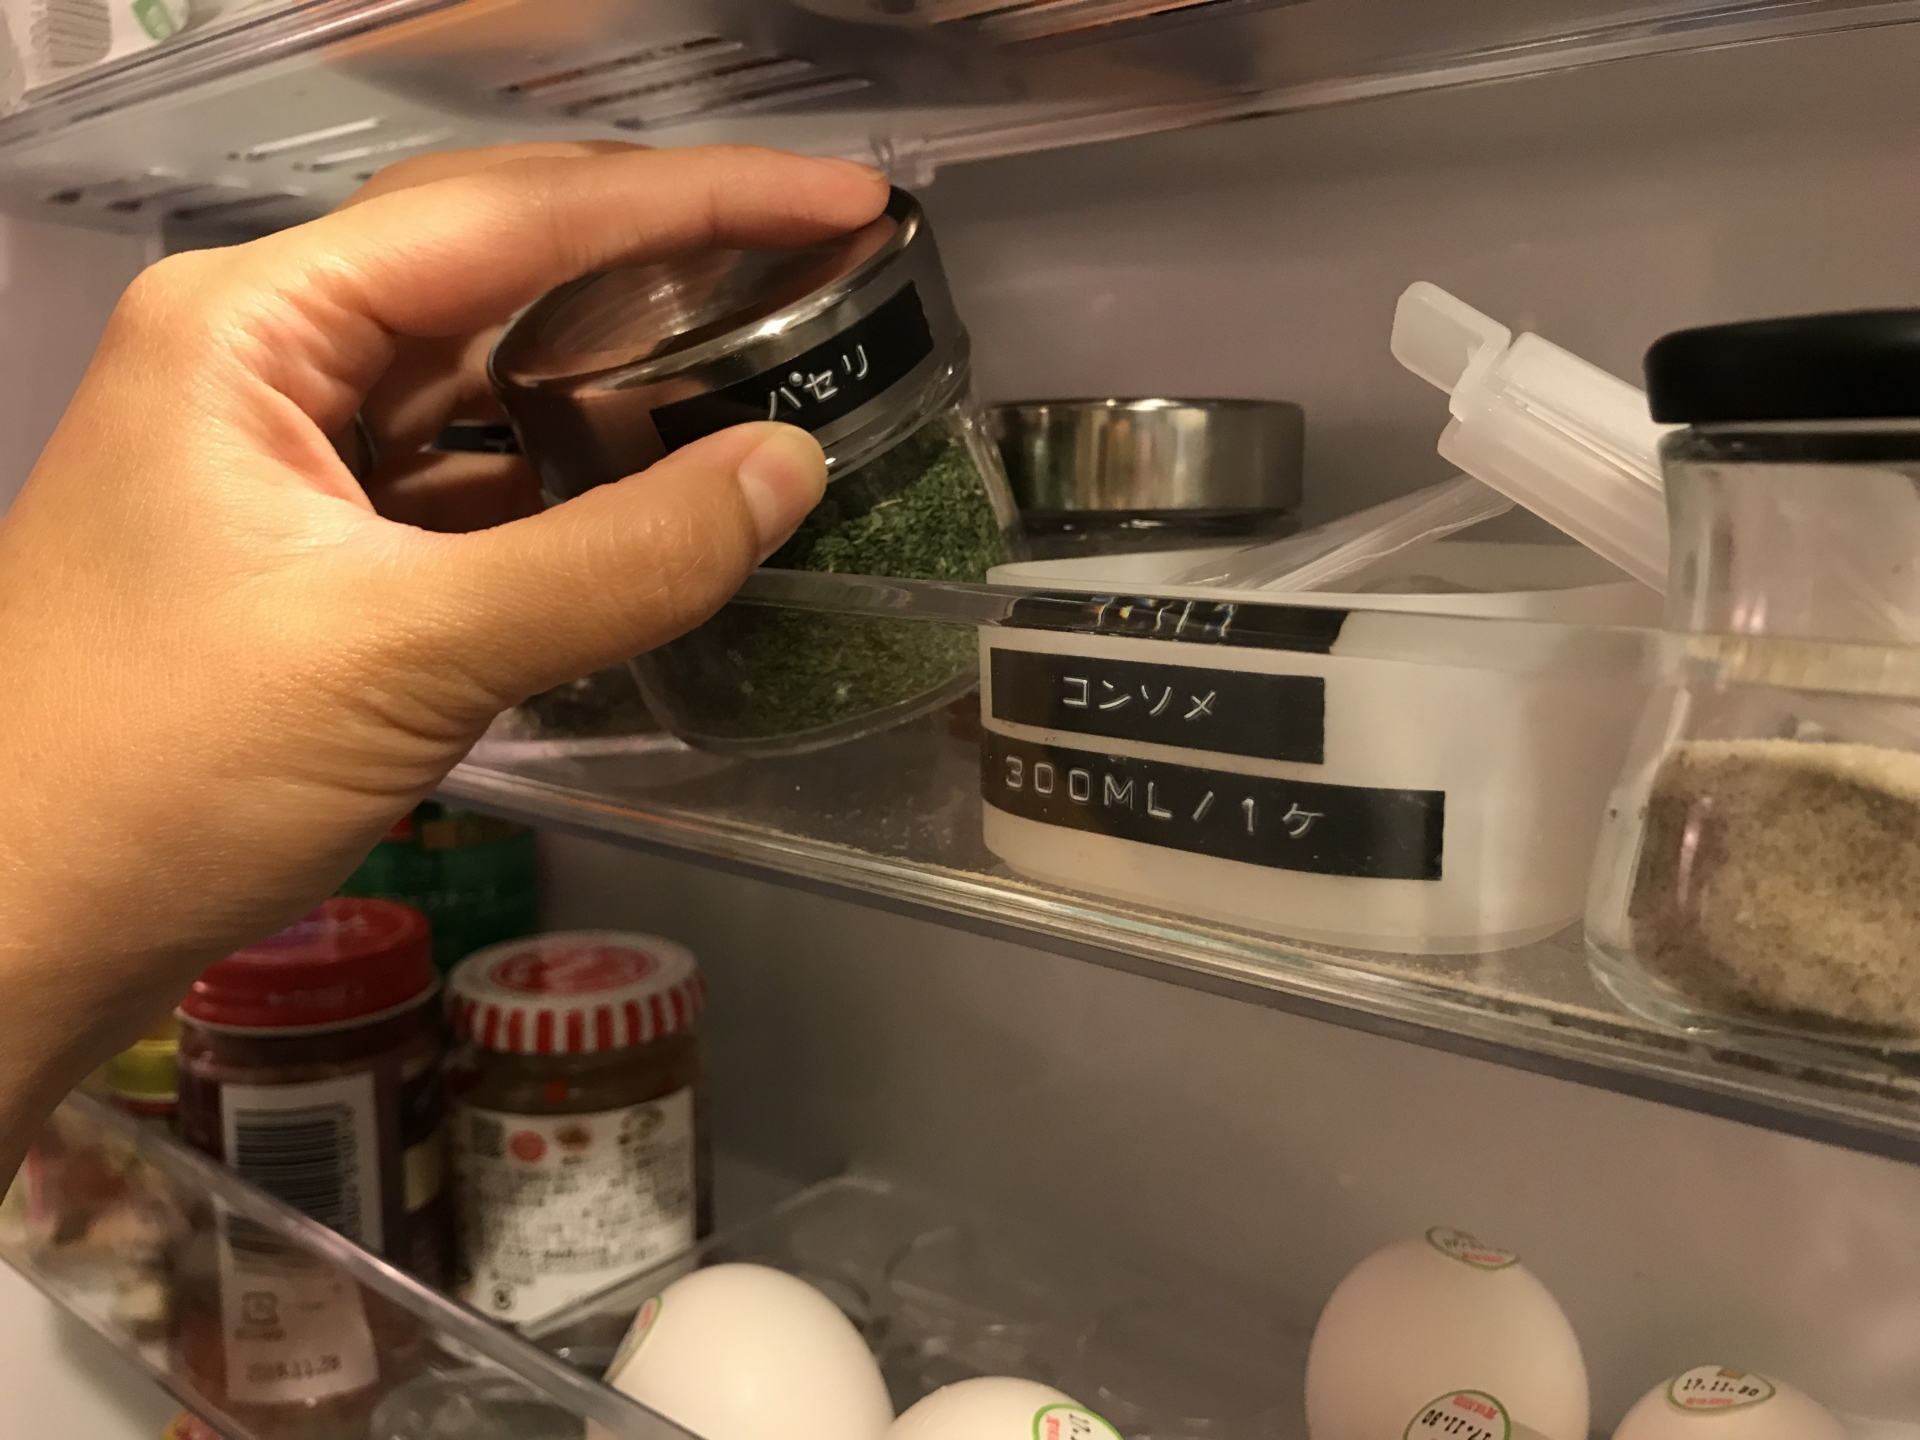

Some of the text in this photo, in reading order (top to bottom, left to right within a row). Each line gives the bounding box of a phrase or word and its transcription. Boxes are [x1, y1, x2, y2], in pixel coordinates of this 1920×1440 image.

[767, 344, 868, 421] パセリ
[1060, 675, 1217, 721] コンソメ
